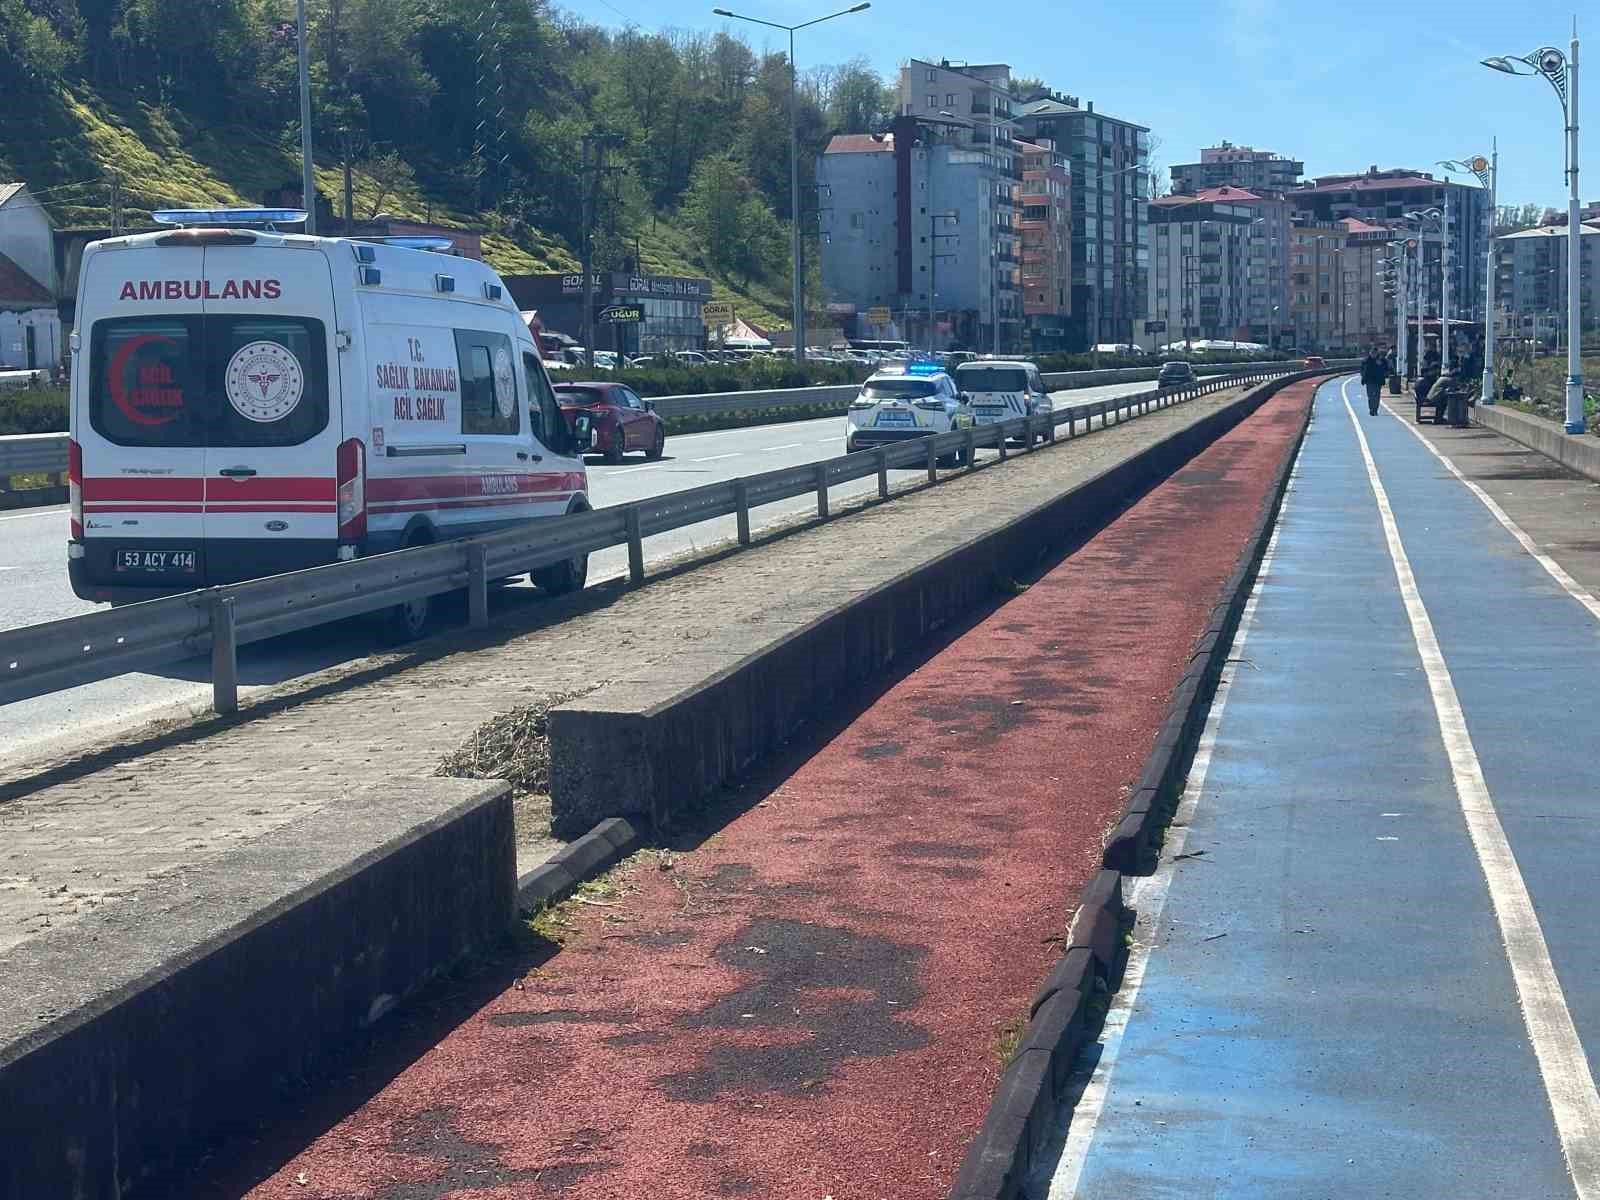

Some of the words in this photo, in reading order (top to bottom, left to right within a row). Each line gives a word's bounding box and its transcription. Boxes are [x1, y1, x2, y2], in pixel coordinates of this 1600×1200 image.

[119, 279, 281, 300] AMBULANS
[407, 338, 425, 362] T.C.
[376, 362, 409, 390] SAĞLIK
[413, 366, 457, 393] BAKANLIĞI
[394, 393, 413, 420] ACİL
[416, 394, 445, 421] SAĞLIK
[125, 552, 140, 566] 53
[144, 553, 166, 567] ACY
[172, 553, 192, 568] 414
